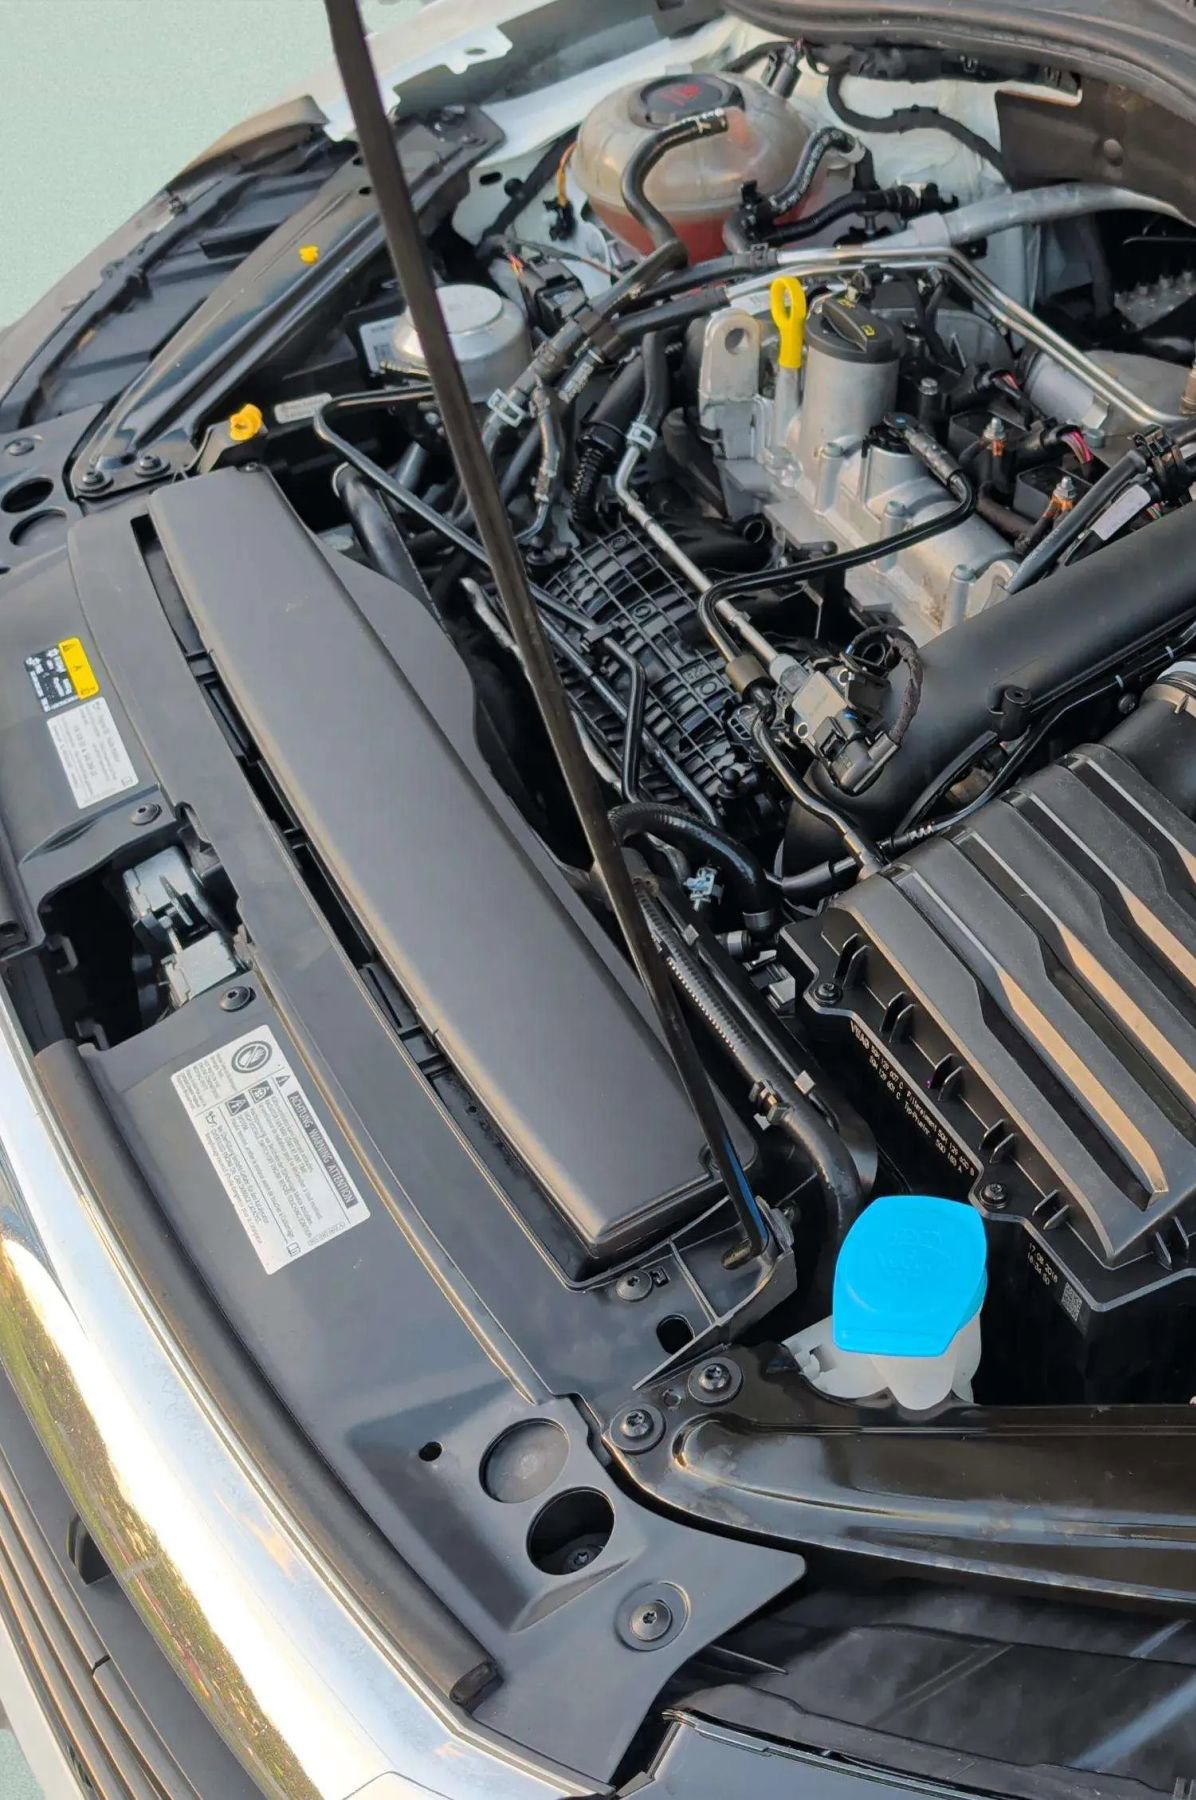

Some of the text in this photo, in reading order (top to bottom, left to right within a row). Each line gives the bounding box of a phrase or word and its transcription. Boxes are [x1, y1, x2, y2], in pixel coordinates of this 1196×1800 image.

[288, 1092, 314, 1129] ACHTUNG
[307, 1127, 333, 1164] WARNING
[326, 1161, 356, 1204] ATTENTION
